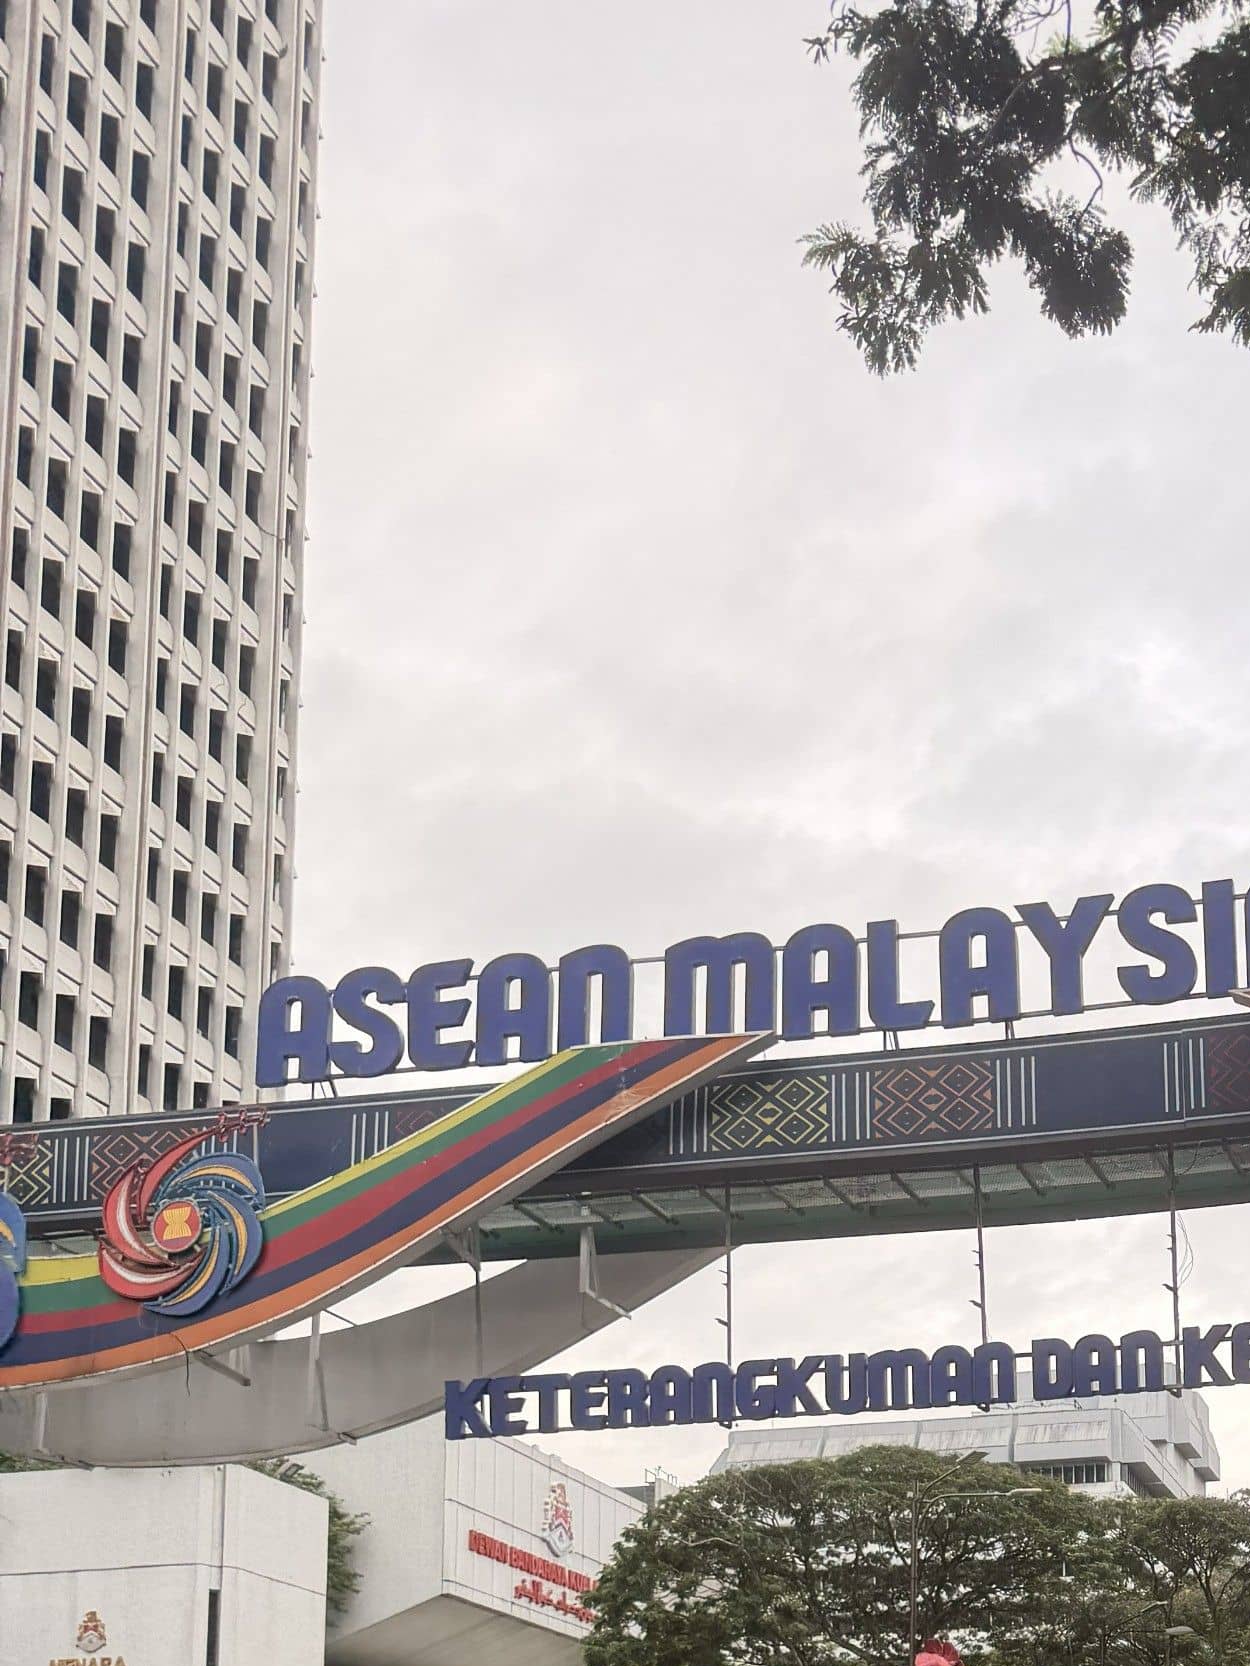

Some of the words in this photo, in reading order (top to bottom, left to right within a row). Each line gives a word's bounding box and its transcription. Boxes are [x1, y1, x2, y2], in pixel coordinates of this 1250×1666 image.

[256, 944, 633, 1088] ASEAN
[444, 1335, 1016, 1440] KETERANGKUMAN
[1032, 1330, 1164, 1400] DAN
[468, 1529, 508, 1564] DEWAN
